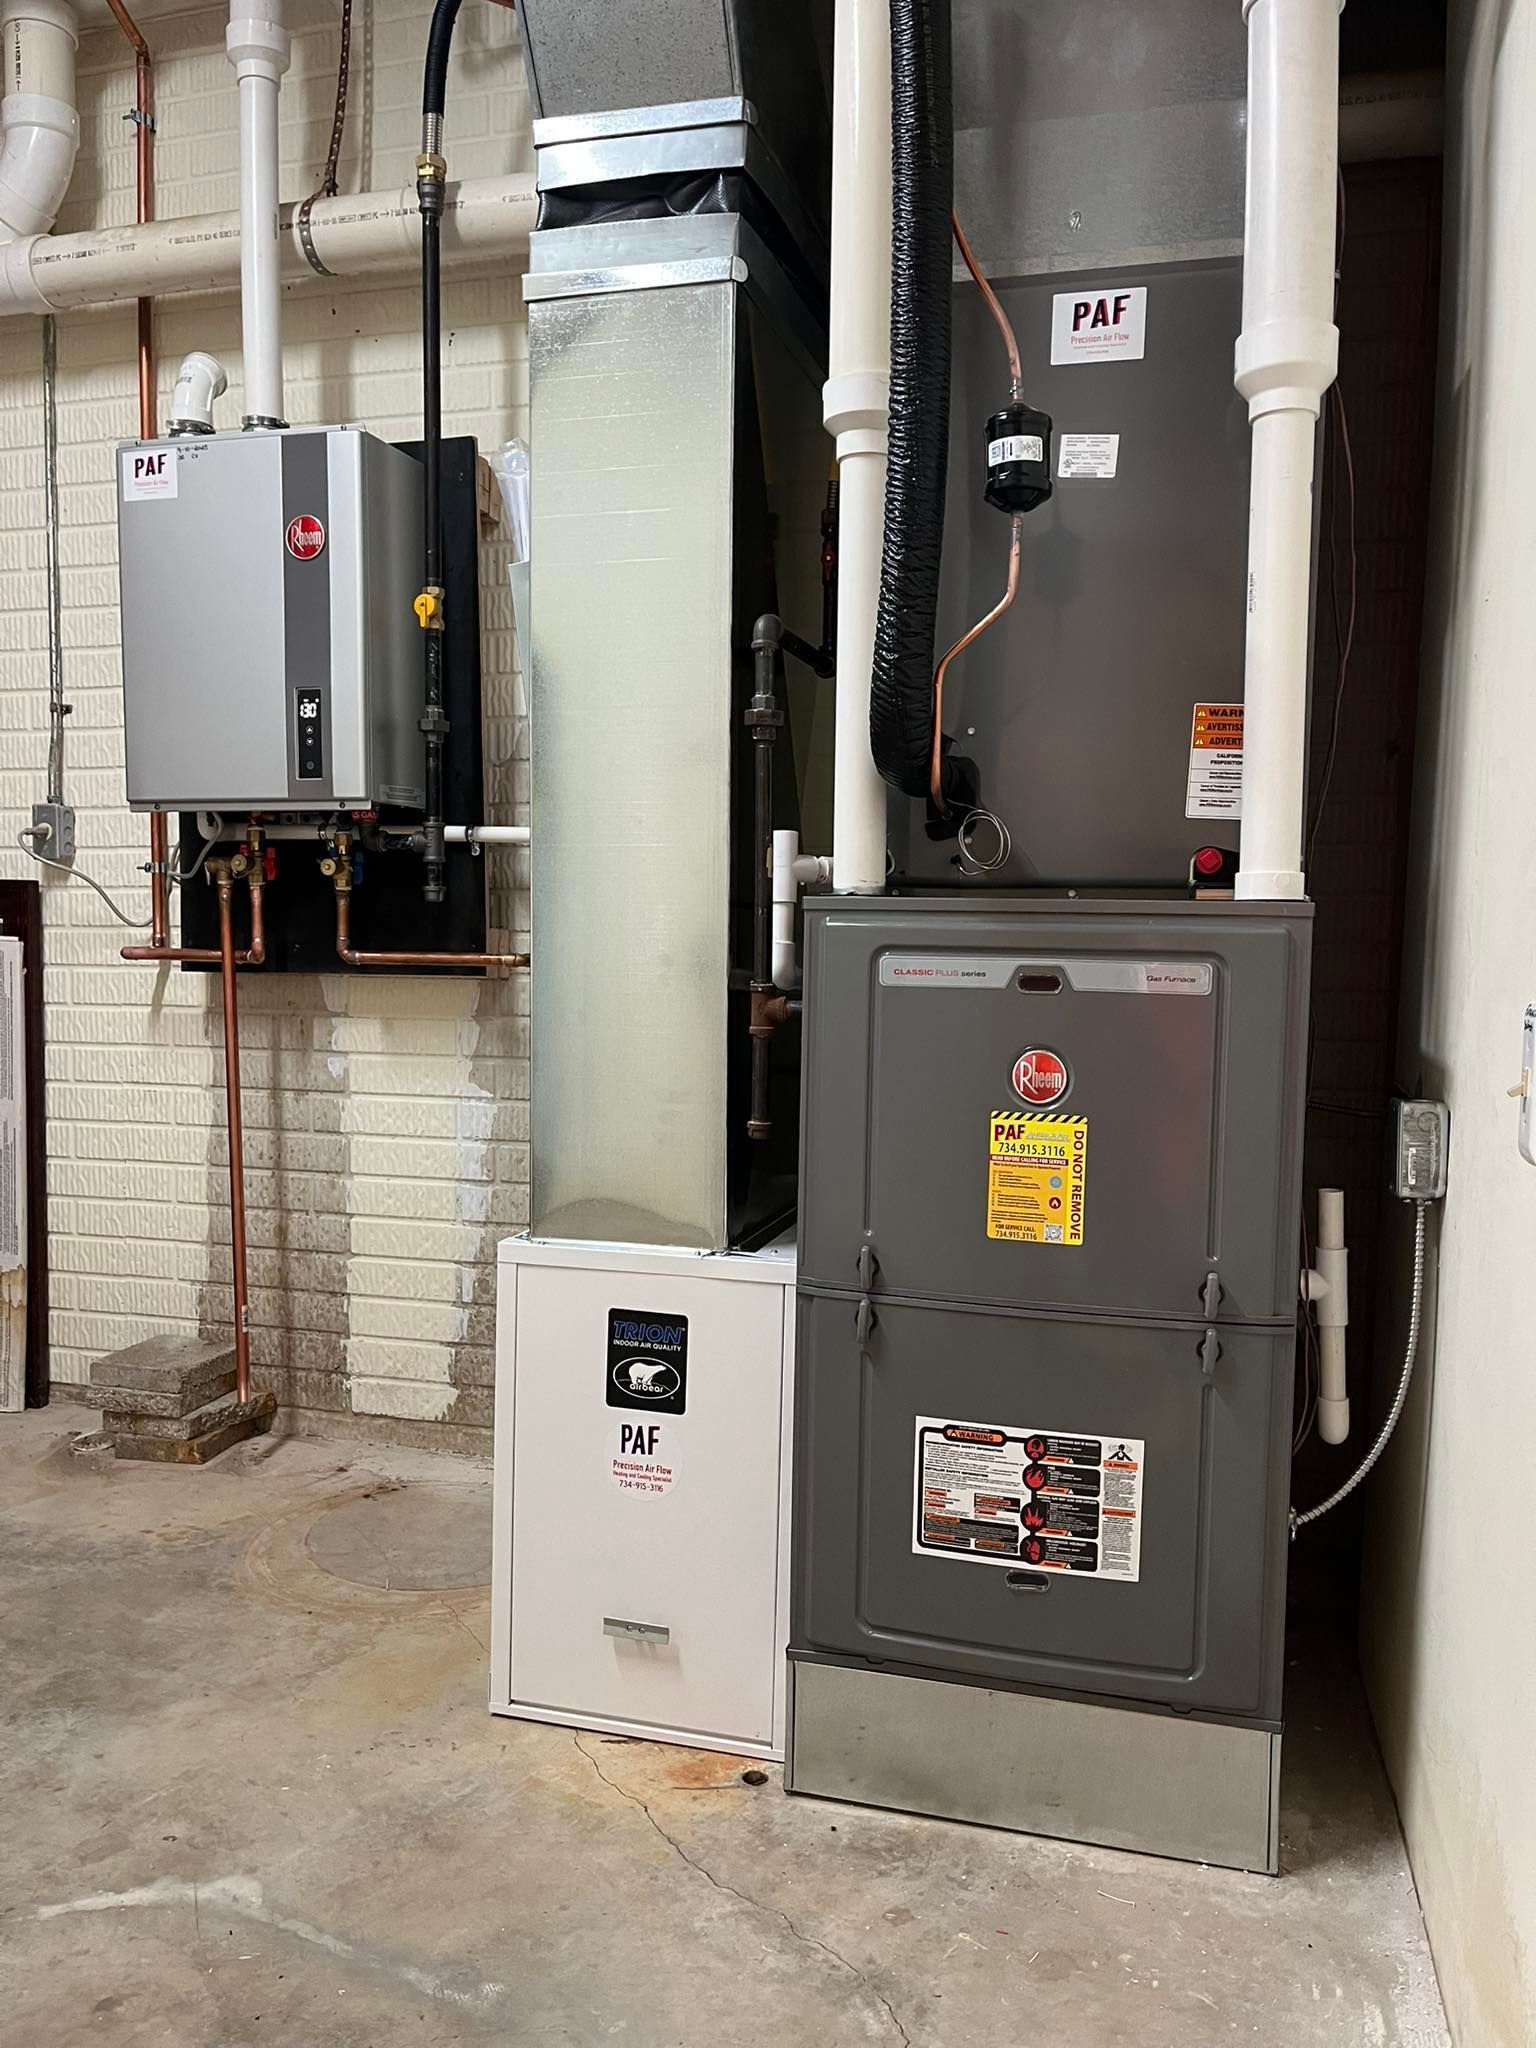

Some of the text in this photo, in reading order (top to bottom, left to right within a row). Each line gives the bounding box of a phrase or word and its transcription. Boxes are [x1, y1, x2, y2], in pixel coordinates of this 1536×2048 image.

[1072, 294, 1131, 332] PAF
[1070, 332, 1130, 345] Precision Air Flow
[134, 453, 167, 479] PAF
[290, 519, 321, 552] Rheem
[300, 703, 317, 718] 130
[893, 968, 986, 977] CLASSIC PLUS series
[1146, 974, 1196, 983] Gas Furnace
[1020, 1055, 1062, 1095] Rheem
[994, 1124, 1026, 1141] PAF
[998, 1142, 1065, 1157] 734.915.3116
[1070, 1130, 1084, 1240] DO NOT REMOVE
[995, 1230, 1037, 1240] 734.915.3116
[614, 1320, 682, 1345] TRION
[613, 1339, 639, 1347] INDOOR
[652, 1343, 681, 1352] QUALITY
[629, 1380, 663, 1393] airbear
[621, 1424, 660, 1455] PAF
[959, 1430, 994, 1441] WARNING
[613, 1459, 672, 1475] Precision Air Flow
[613, 1470, 628, 1478] Heating
[637, 1473, 651, 1481] Cooling
[619, 1479, 664, 1492] 734-915-3116
